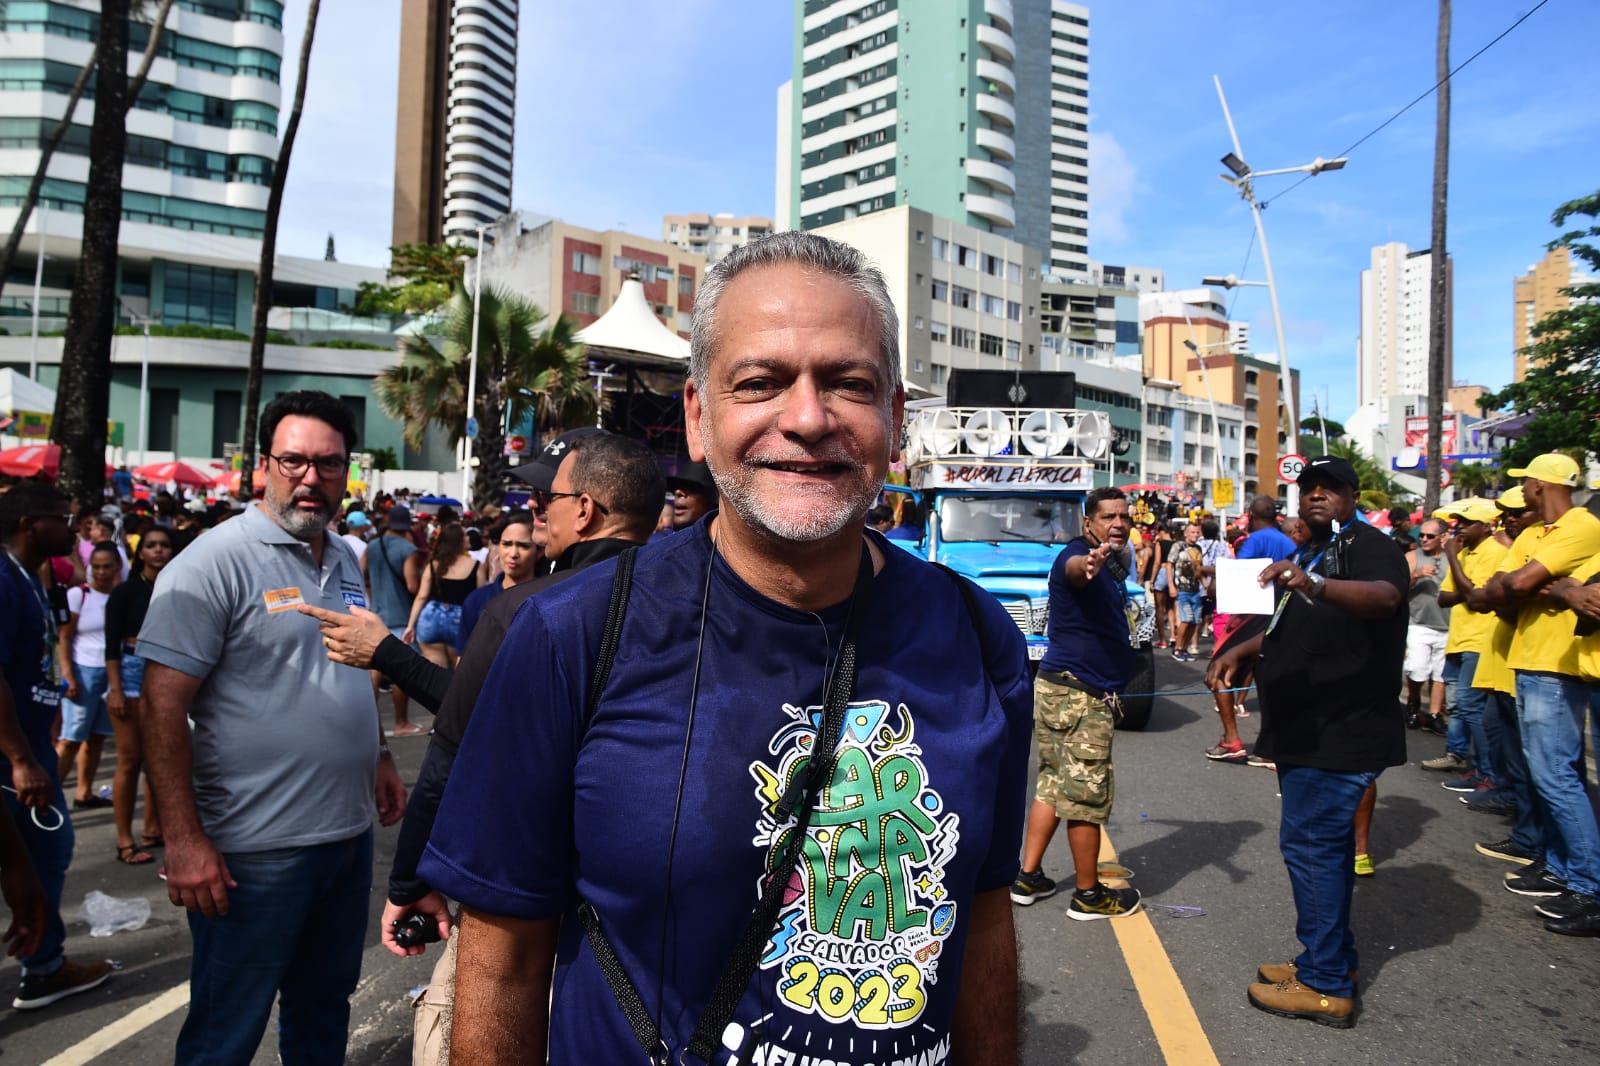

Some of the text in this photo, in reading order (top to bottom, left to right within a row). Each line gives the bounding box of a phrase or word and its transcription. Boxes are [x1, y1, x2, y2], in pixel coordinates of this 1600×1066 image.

[945, 466, 1004, 484] #RURAL
[1283, 462, 1303, 474] 50
[799, 934, 911, 966] SALVADOR
[781, 957, 926, 1025] 2023
